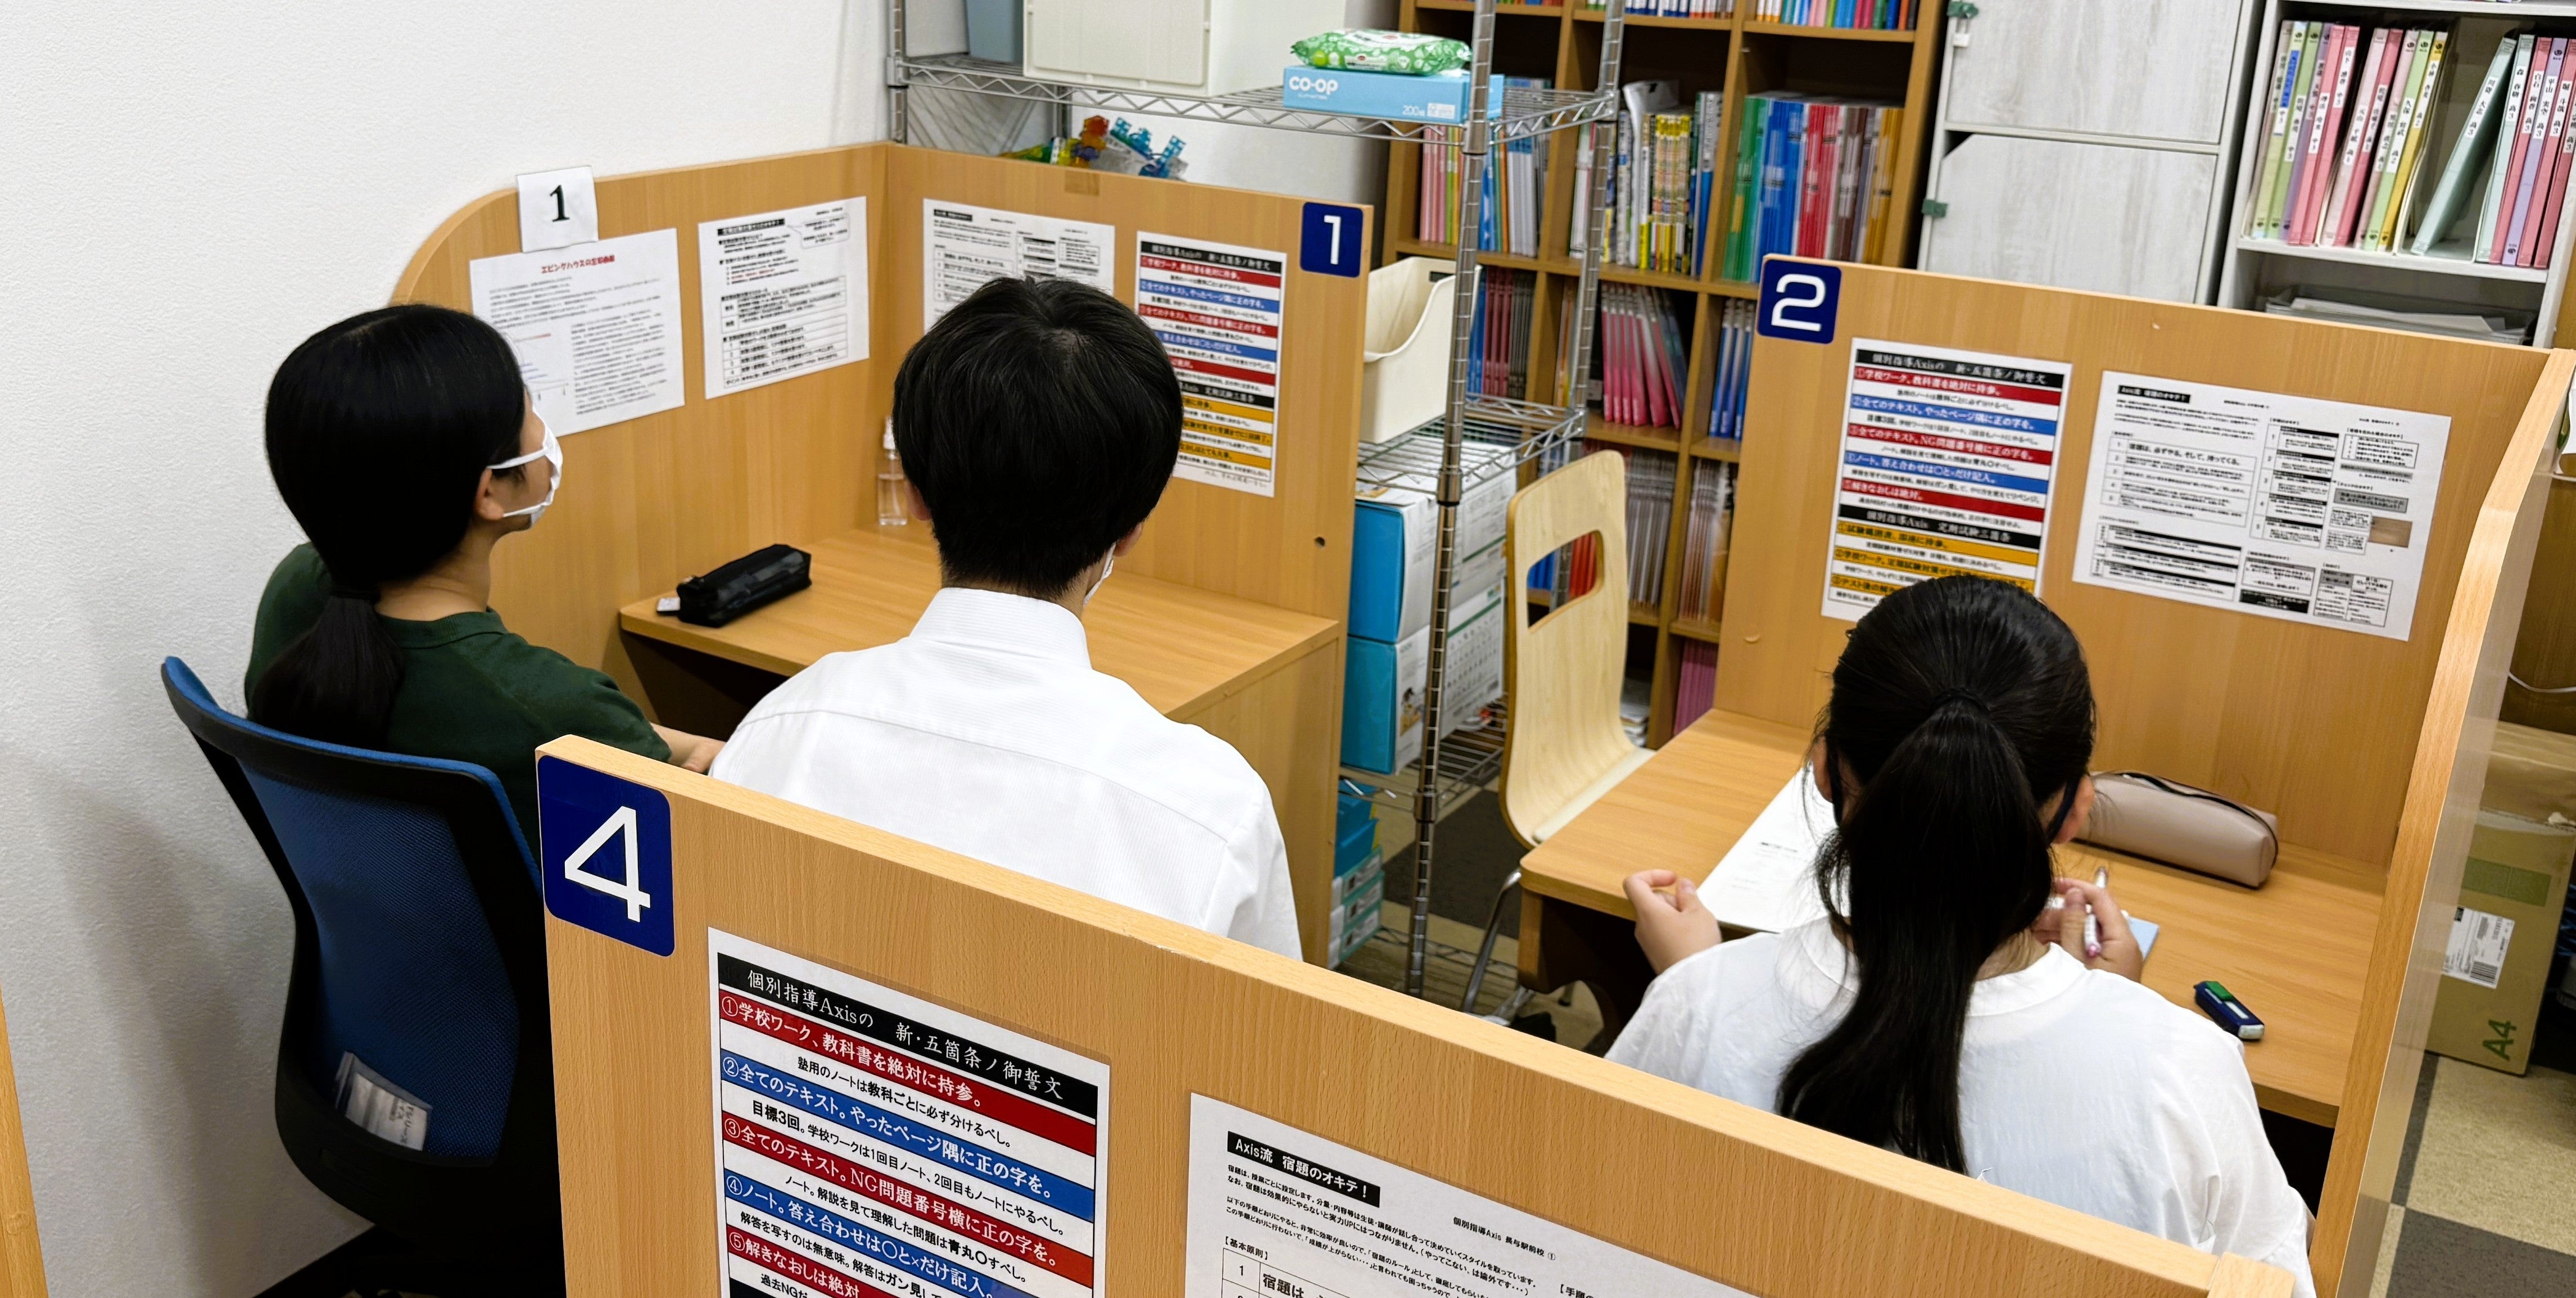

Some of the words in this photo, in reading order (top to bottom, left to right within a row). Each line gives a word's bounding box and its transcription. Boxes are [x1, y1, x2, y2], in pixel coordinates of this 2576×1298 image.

[550, 184, 570, 222] 1
[1324, 215, 1341, 265] 1
[1771, 273, 1826, 332] 2
[564, 806, 650, 922] 4
[722, 997, 982, 1107] ①学校ワーク、教科書を絶対に持参。
[748, 970, 873, 1029] 個別指導Axisの
[896, 1023, 1064, 1100] 新・五箇条ノ御誓文
[2482, 1019, 2517, 1061] A4
[723, 1057, 1051, 1198] ②全てのテキスト。やったページ隅に正の字を。
[798, 1057, 1011, 1147] 塾用のノートは教科ごとに必ず分けるべし。
[725, 1118, 1056, 1267] ③全てのテキスト。NG問題番号横に正の字を。
[1235, 1138, 1273, 1164] Axis流
[740, 1211, 942, 1298] 解答を写すのは無意味。解答はガン見し
[1239, 1265, 1244, 1276] 1
